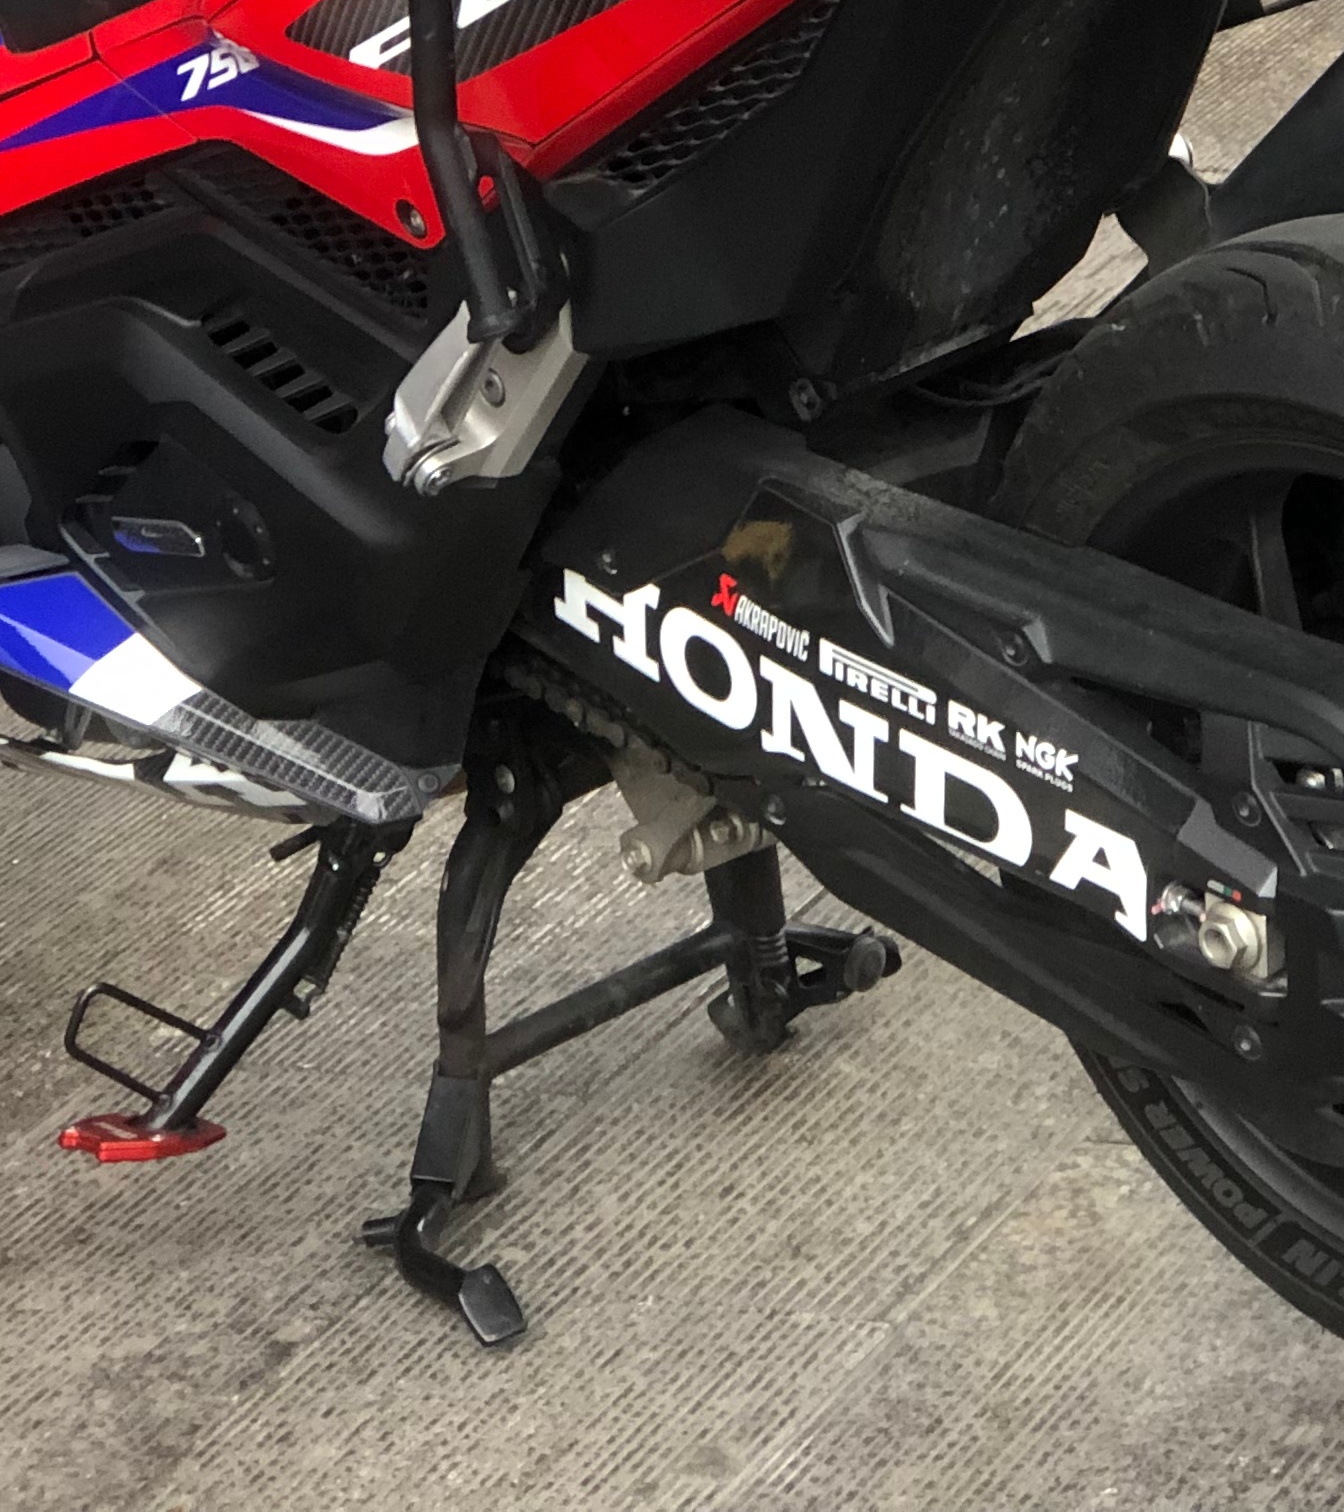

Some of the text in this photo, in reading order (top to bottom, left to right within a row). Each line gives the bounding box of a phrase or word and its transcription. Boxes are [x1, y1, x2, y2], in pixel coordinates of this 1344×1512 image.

[553, 568, 1150, 942] HONDA
[818, 637, 937, 726] PIRELLI
[948, 699, 1006, 753] RK
[1016, 731, 1079, 783] NGK
[1143, 1098, 1266, 1231] POWER
